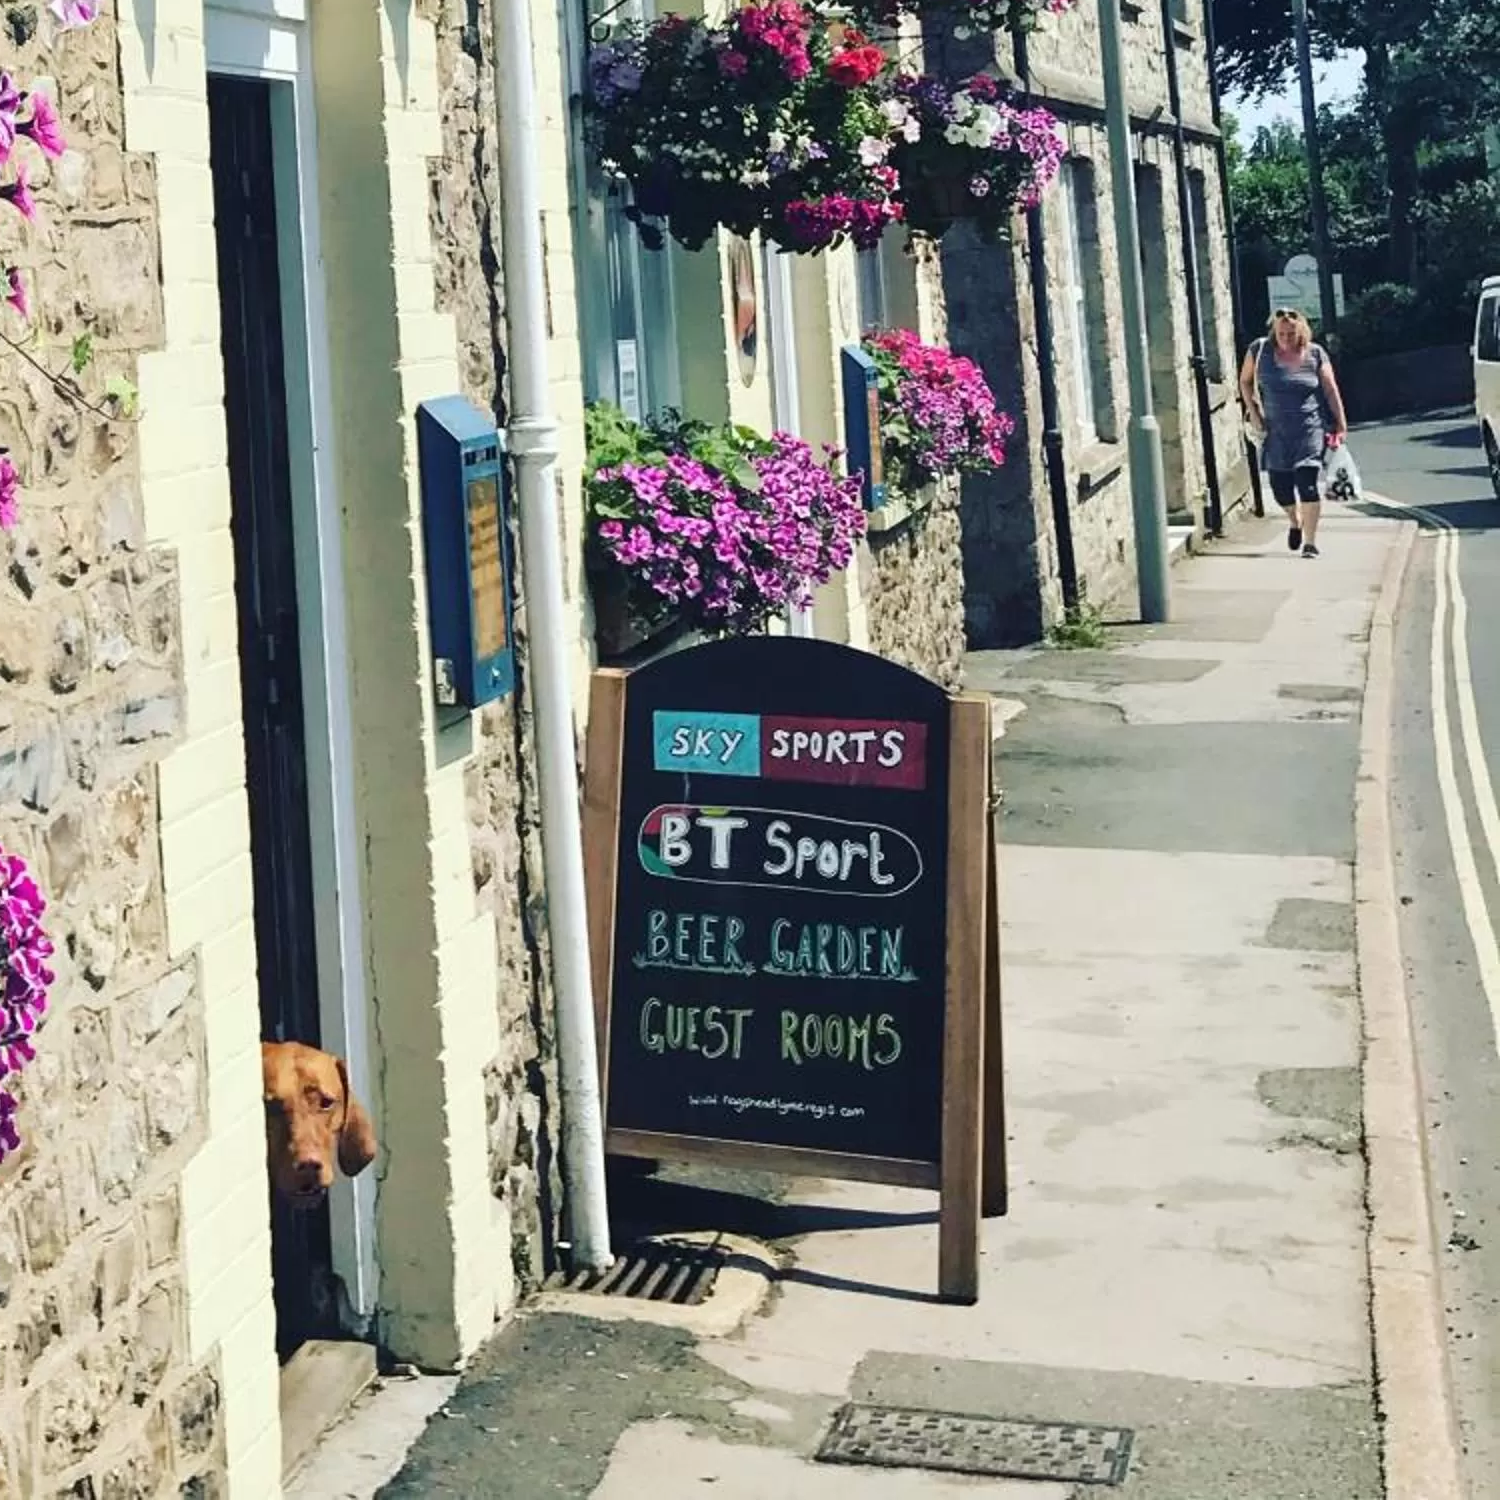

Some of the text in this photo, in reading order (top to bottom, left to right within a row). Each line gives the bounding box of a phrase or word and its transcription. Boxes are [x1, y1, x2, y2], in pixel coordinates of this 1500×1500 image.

[669, 725, 905, 768] SKY SPORTS
[658, 812, 895, 887] BT Sport
[648, 911, 904, 977] BEER GARDEN
[639, 997, 902, 1071] GUEST ROOMS
